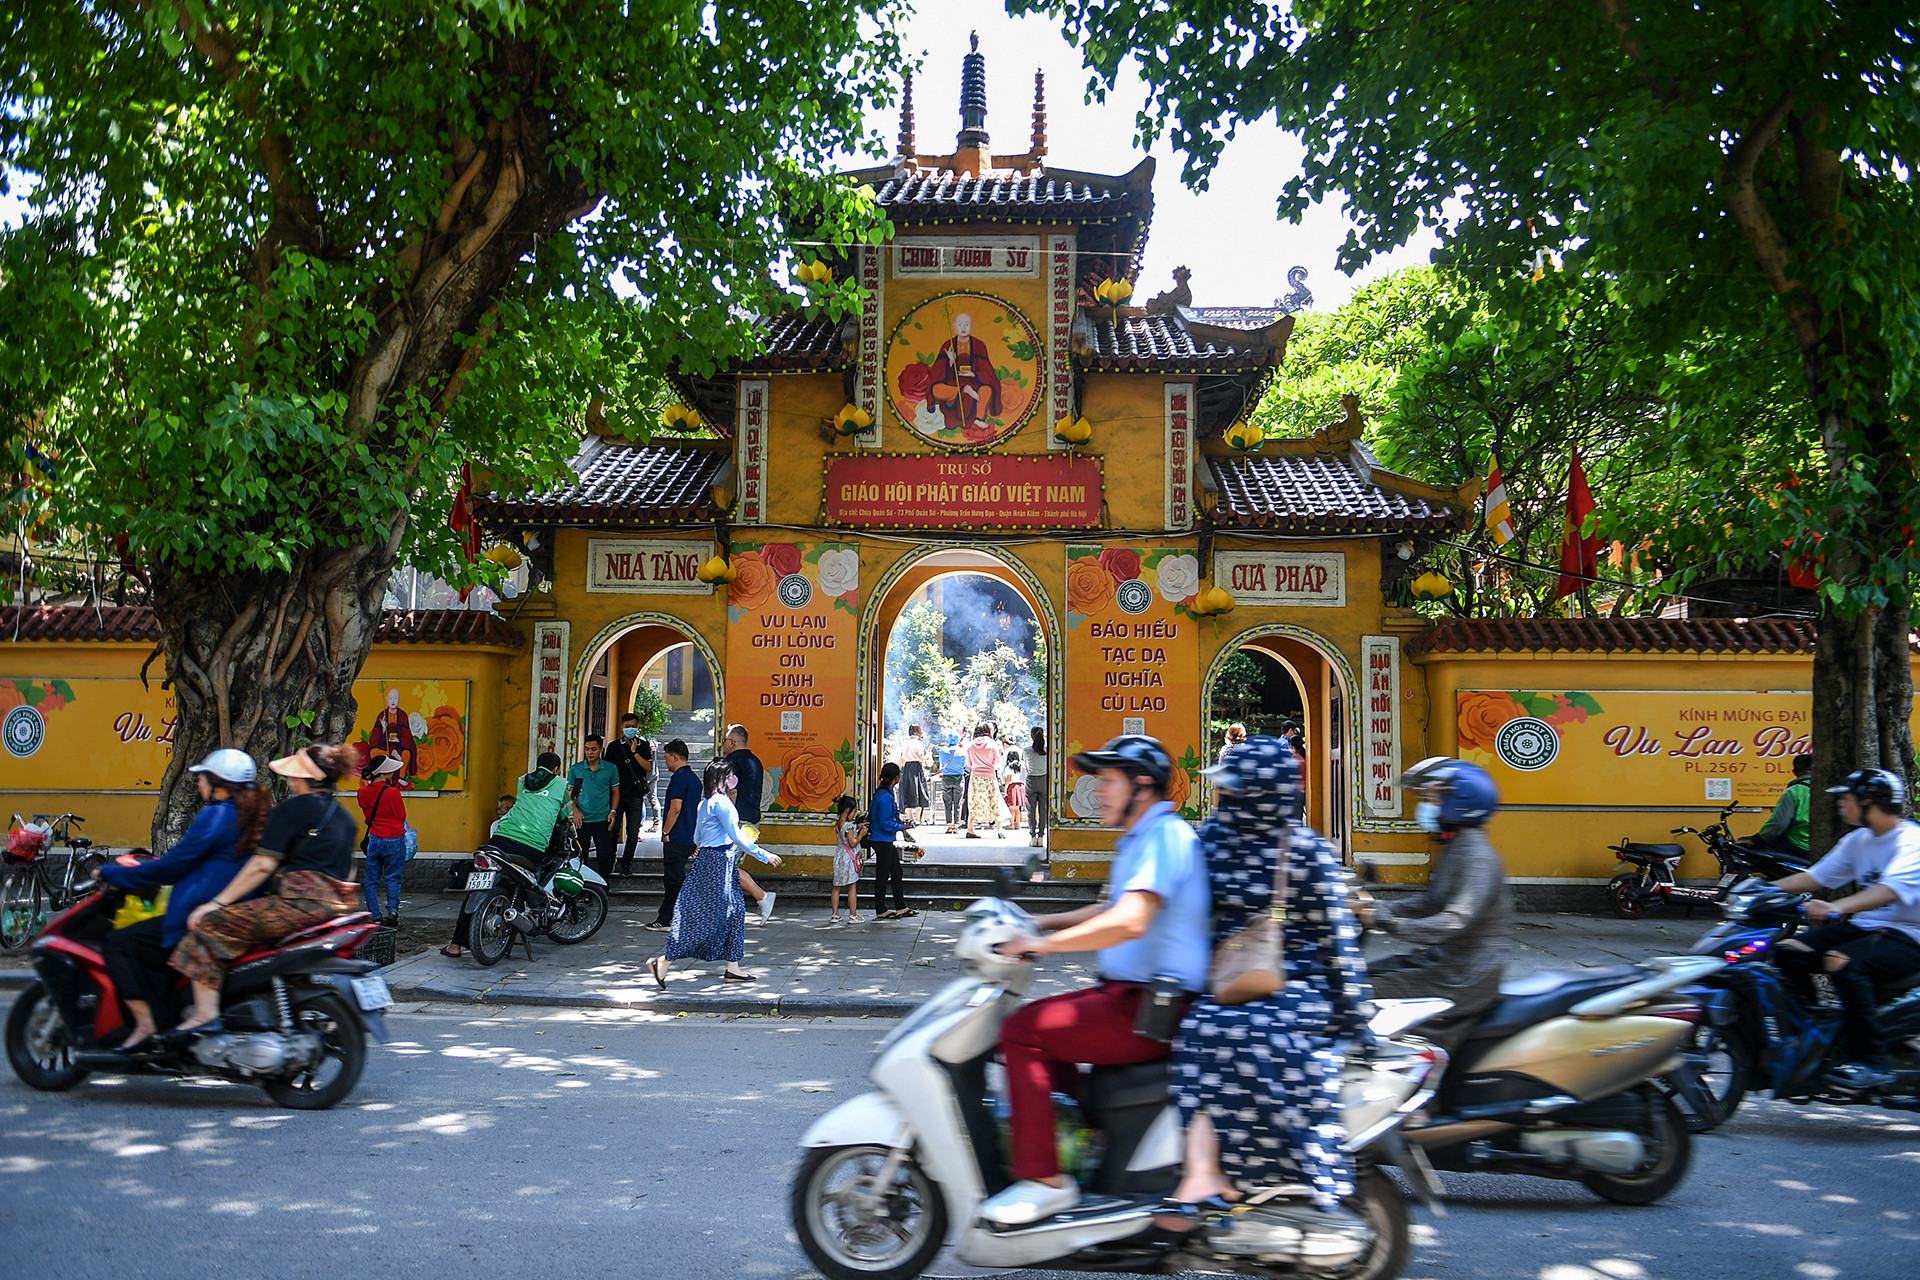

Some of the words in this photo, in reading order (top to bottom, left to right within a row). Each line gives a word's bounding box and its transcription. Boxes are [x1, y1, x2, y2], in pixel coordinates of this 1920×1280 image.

[937, 463, 968, 478] TRỤ
[971, 460, 992, 476] SỞ
[841, 480, 880, 502] GIÁO
[885, 480, 912, 505] HỘI
[916, 481, 959, 506] PHẬT
[962, 481, 1001, 502] GIÁO
[1006, 482, 1042, 506] VIỆT
[1046, 485, 1085, 503] NAM
[859, 508, 872, 516] Chùa
[905, 508, 914, 516] Phố
[605, 552, 647, 581] NHÀ
[650, 550, 699, 581] TĂNG
[1274, 564, 1328, 593] PHÁP
[760, 615, 788, 629] VU
[791, 615, 828, 630] LAN
[1090, 620, 1130, 639] BÁO
[1134, 618, 1178, 640] HIẾU
[542, 630, 560, 650] CHÙA
[752, 634, 783, 648] GHI
[788, 632, 836, 650] LÒNG
[780, 654, 807, 668] ƠN
[1101, 648, 1137, 667] TẠC
[1142, 648, 1168, 668] DẠ
[1370, 653, 1390, 672] ĐẠO
[770, 673, 815, 688] SINH
[1104, 668, 1164, 688] NGHĨA
[760, 690, 825, 708] DƯỠNG
[1102, 692, 1126, 712] CÙ
[1130, 696, 1168, 712] LAO
[1372, 692, 1391, 712] NỐI
[1679, 708, 1718, 722] KÍNH
[1723, 708, 1774, 722] MỪNG
[1778, 710, 1807, 724] ĐẠI
[114, 712, 153, 744] Vu
[538, 721, 557, 739] PHẬT
[1603, 726, 1662, 758] Vu
[1668, 726, 1744, 758] Lan
[1372, 764, 1392, 782] PHẬT
[1684, 762, 1748, 774] PL.2567
